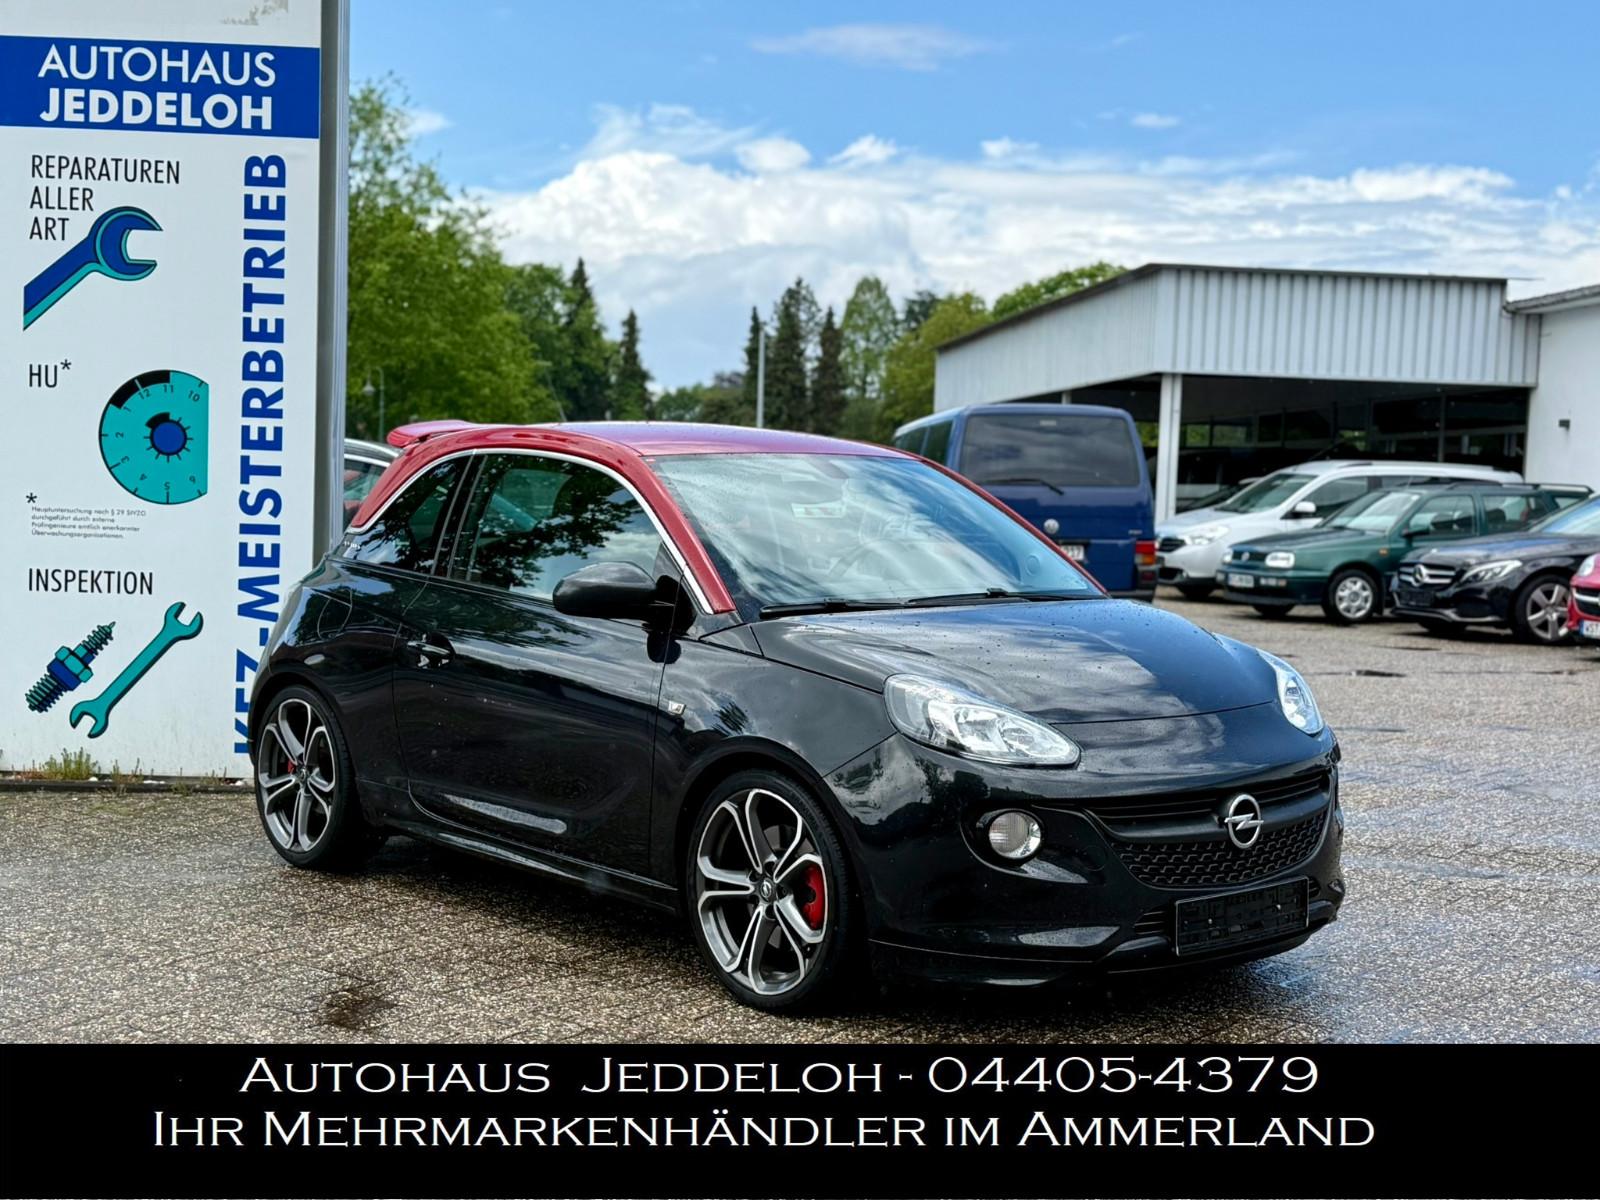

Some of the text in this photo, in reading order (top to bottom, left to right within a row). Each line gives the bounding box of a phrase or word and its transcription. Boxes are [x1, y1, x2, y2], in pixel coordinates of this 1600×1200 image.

[38, 44, 276, 87] AUTOHAUS
[39, 87, 272, 130] JEDDELOH
[31, 154, 180, 185] REPARATUREN
[30, 185, 94, 212] ALLER
[29, 216, 70, 241] ART
[138, 388, 151, 400] 12
[188, 390, 200, 402] 10
[28, 567, 153, 596] INSPEKTION
